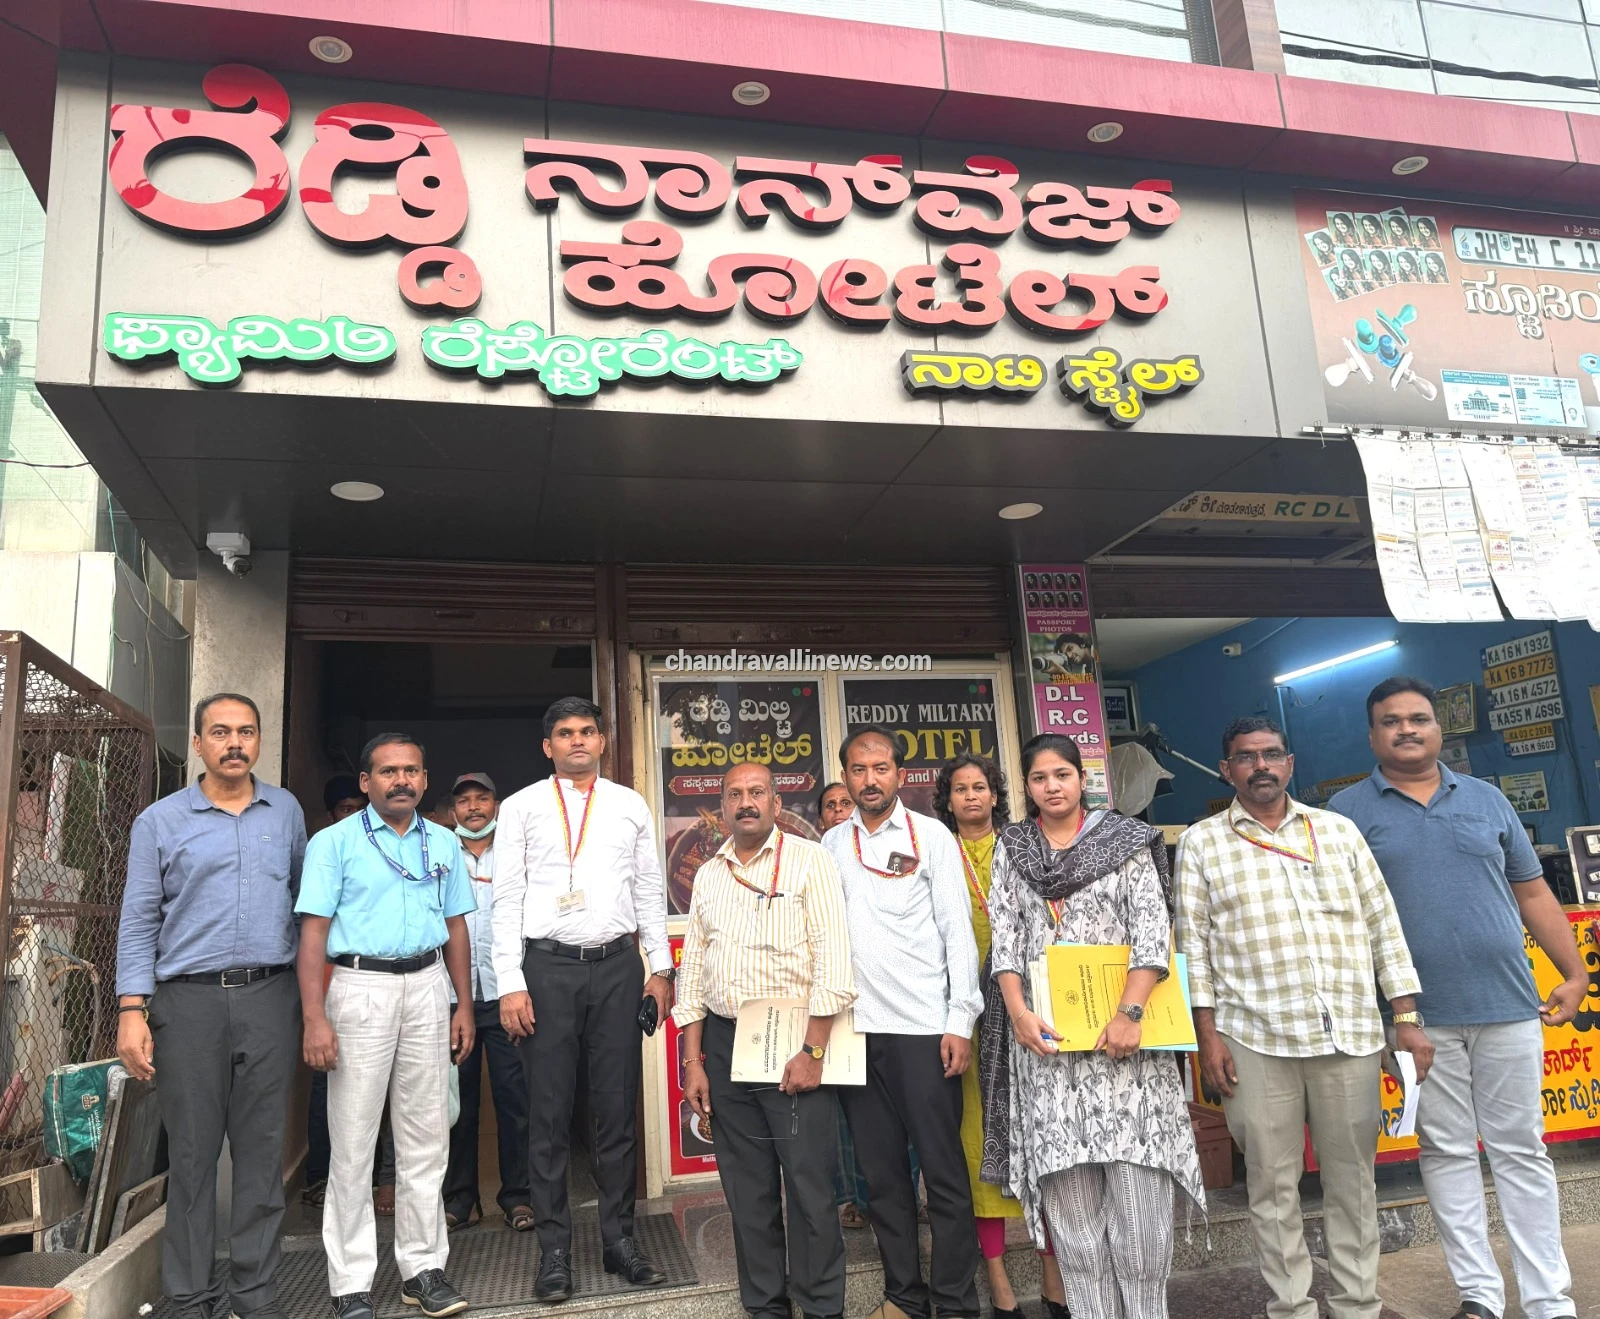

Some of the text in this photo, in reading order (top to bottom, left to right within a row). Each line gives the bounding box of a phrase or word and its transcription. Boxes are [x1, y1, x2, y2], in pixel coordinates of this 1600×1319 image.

[108, 63, 482, 313] ರೆಡ್ಡಿ
[1474, 231, 1501, 260] JH
[1512, 235, 1540, 265] 24
[1549, 239, 1565, 267] C
[560, 220, 1168, 337] ಹೋಟೆಲ್
[111, 316, 798, 391] ಫ್ಯಾಮಿಲಿ ರೆಸ್ಟೋರೆಂಟ್
[910, 348, 1201, 419] ನಾಟಿ ಸ್ಟೈಲ್
[1487, 650, 1500, 664] KA
[1502, 645, 1514, 660] 16
[1524, 636, 1549, 654] 1932
[1489, 670, 1502, 684] KA
[1505, 667, 1516, 681] 16
[1528, 657, 1554, 675] 7773
[1045, 685, 1085, 702] D.L
[1508, 688, 1520, 702] 16
[1531, 680, 1558, 697] 4572
[689, 695, 731, 734] ರೆಡ್ಡಿ
[847, 702, 996, 724] REDDY MILTARY
[1047, 709, 1089, 725] R.C
[1535, 702, 1561, 719] 4696
[671, 733, 812, 767] ಹೋಟೆಲ್
[895, 728, 995, 761] OTEL
[1044, 731, 1100, 744] rds
[907, 769, 930, 783] and
